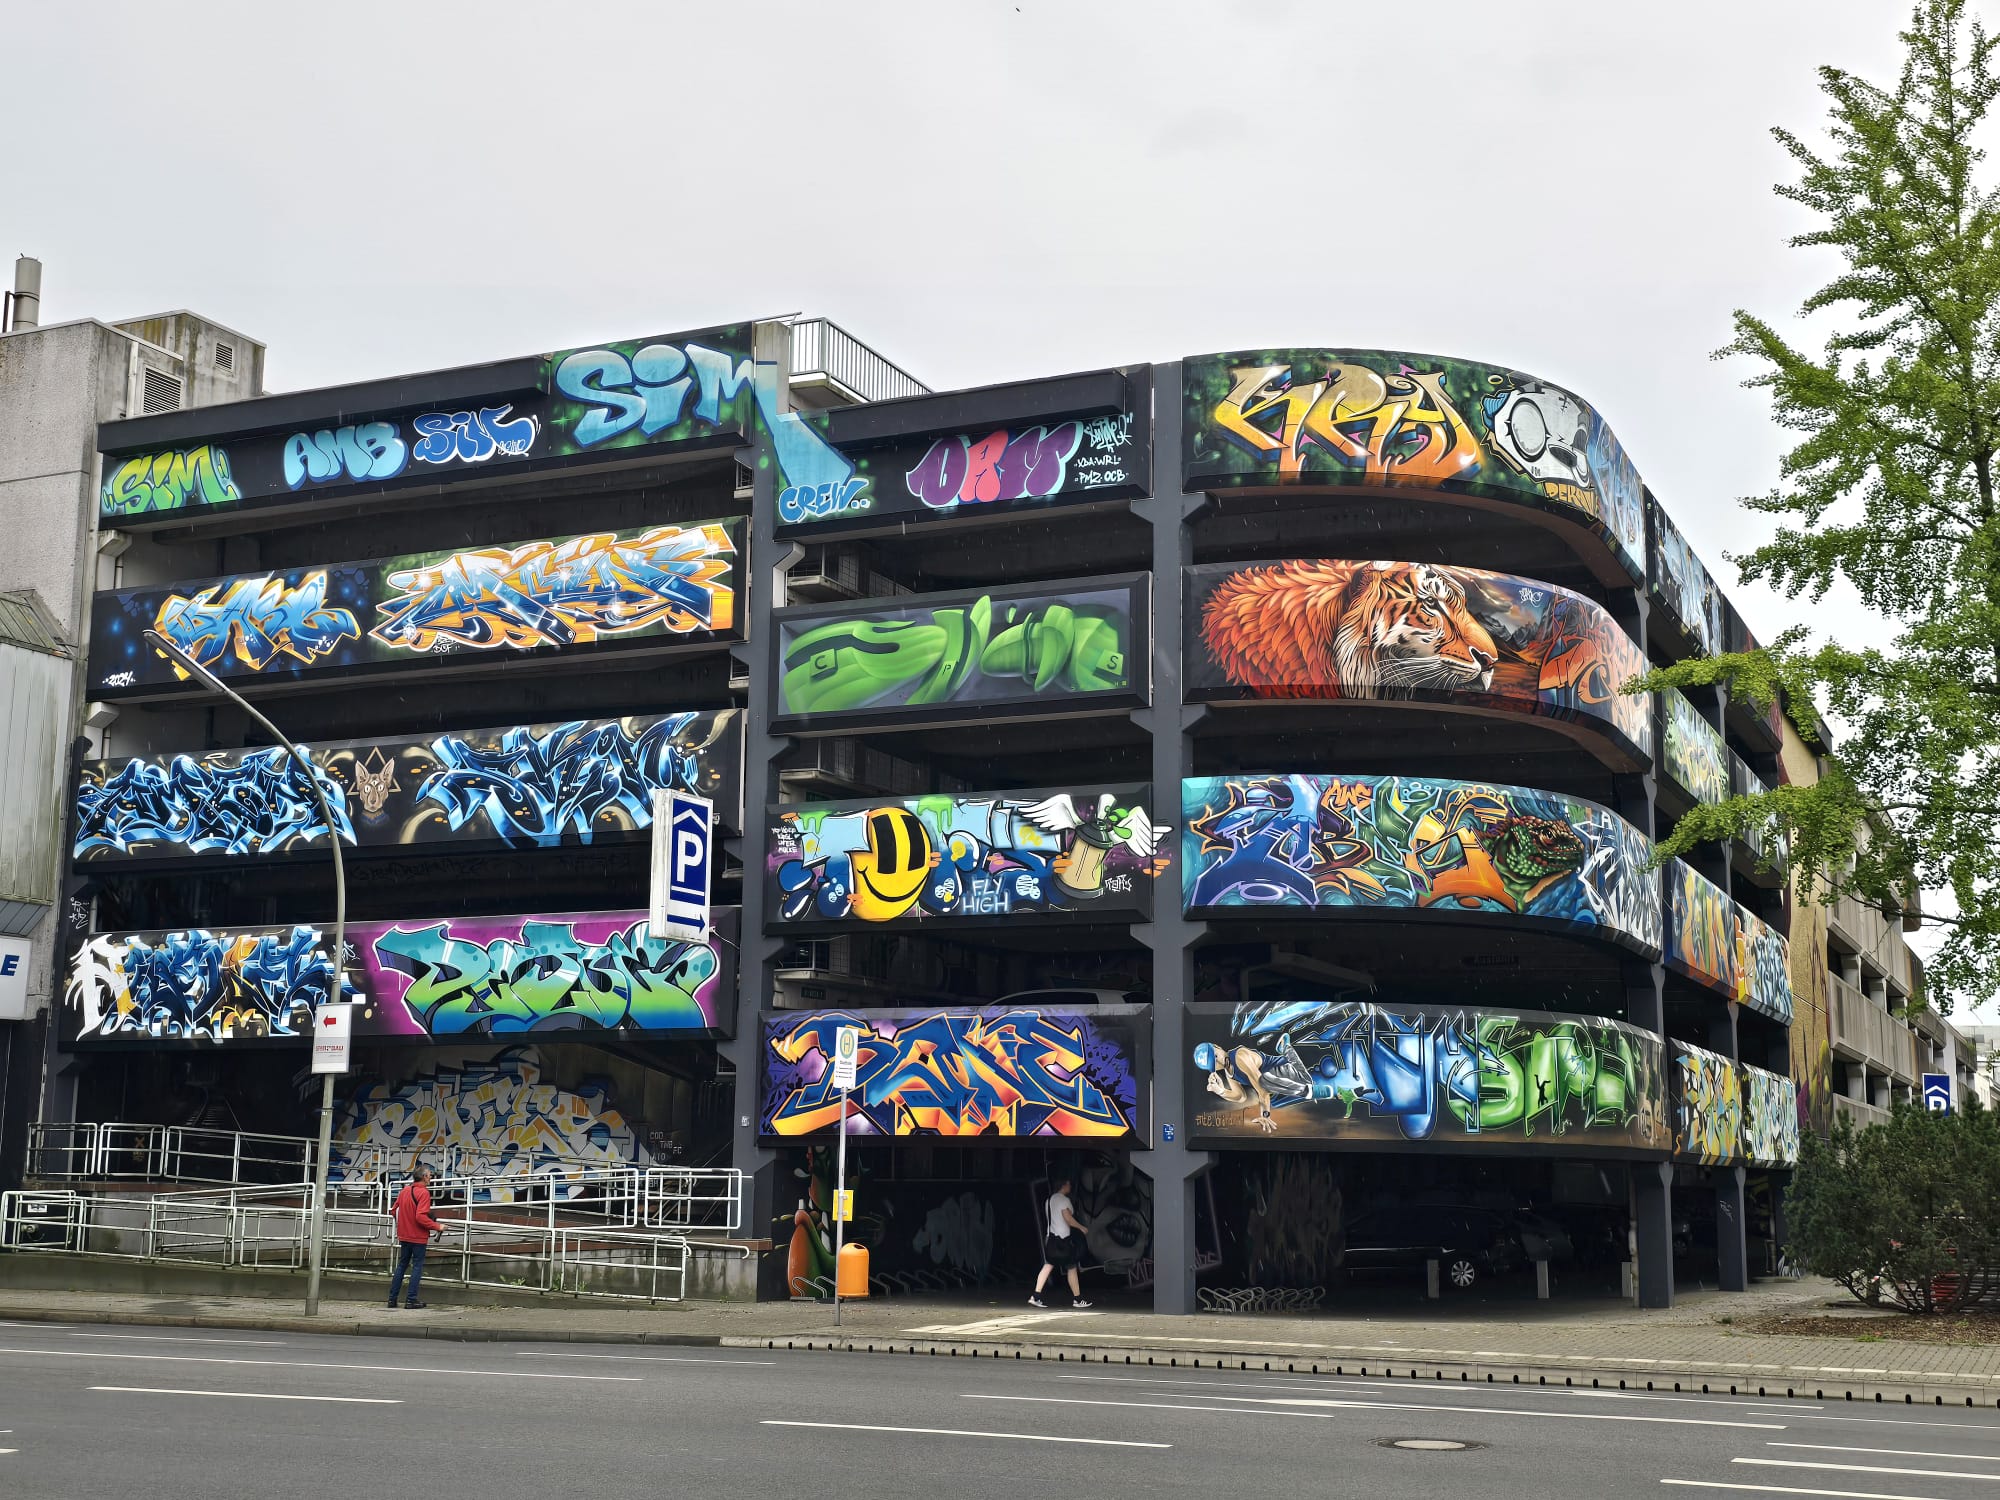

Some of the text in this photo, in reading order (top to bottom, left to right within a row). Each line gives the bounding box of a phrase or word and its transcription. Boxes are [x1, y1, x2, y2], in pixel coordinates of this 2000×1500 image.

[283, 421, 409, 491] AMB
[676, 829, 704, 883] P
[962, 892, 1009, 913] HIGH
[972, 875, 1003, 897] FLY
